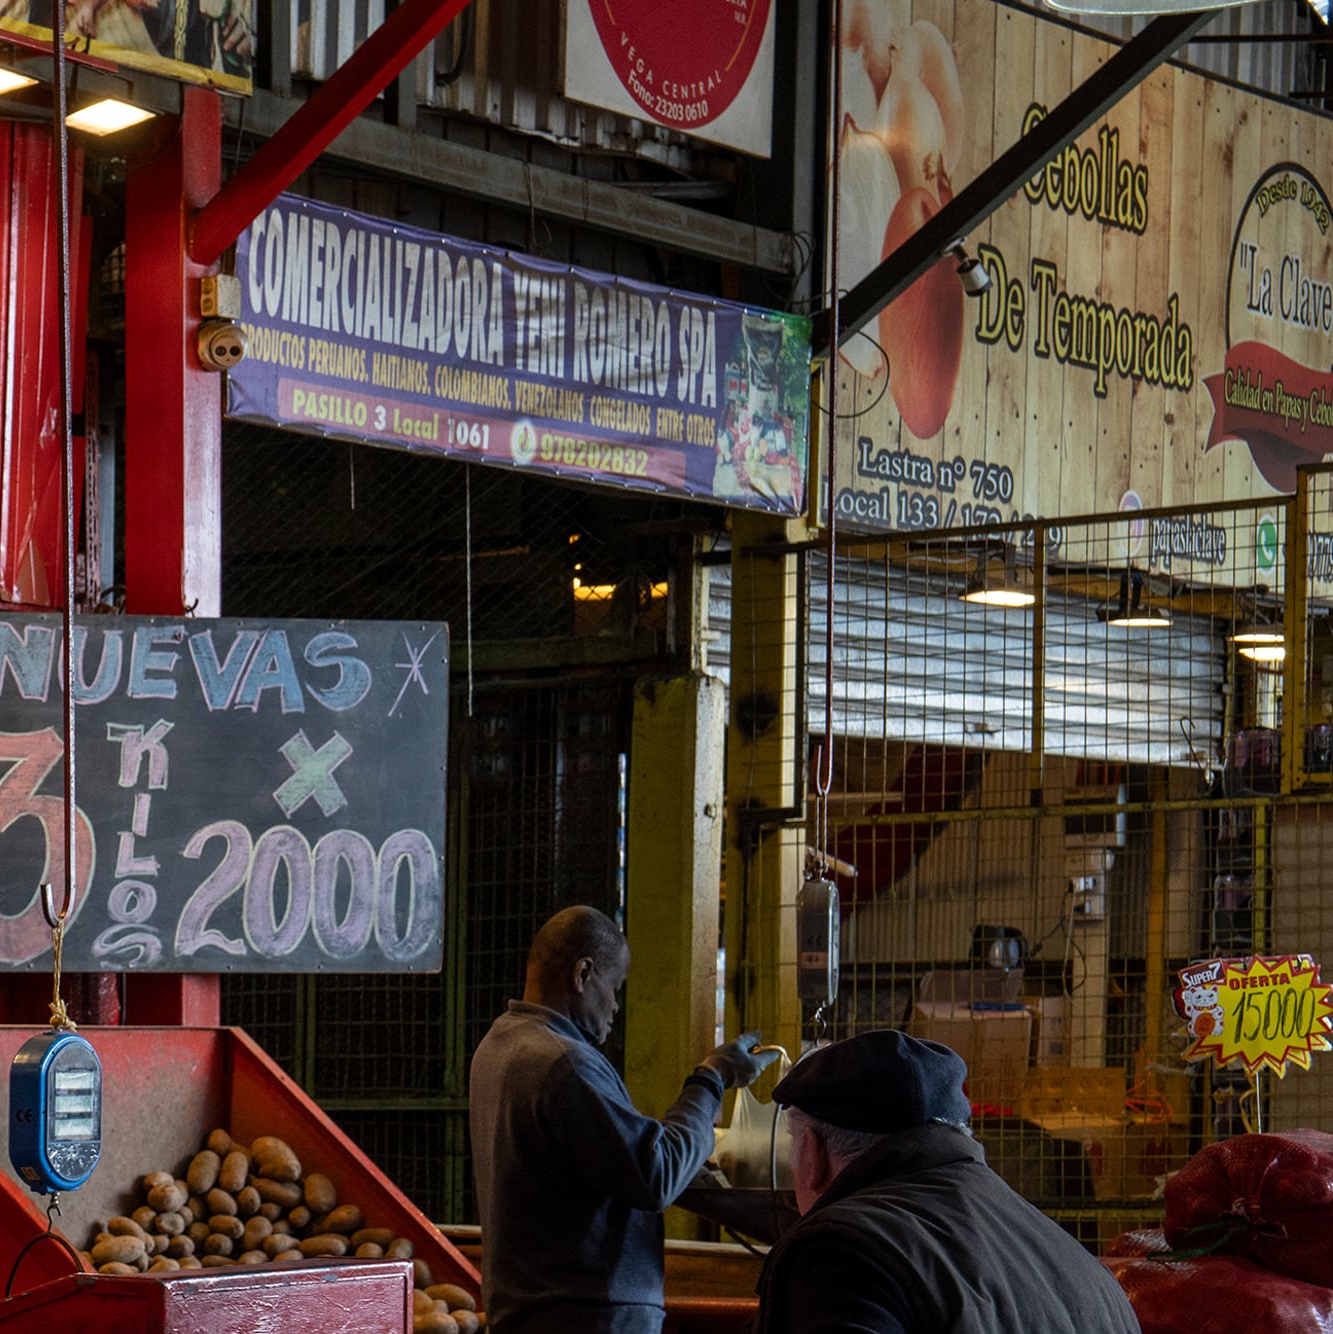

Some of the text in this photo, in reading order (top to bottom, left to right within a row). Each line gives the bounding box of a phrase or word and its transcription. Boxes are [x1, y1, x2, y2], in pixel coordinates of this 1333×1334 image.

[621, 32, 722, 99] VEGA CENTRAL
[628, 70, 655, 108] Fono:
[685, 99, 708, 121] 0610
[1256, 173, 1331, 235] Desde 1942
[248, 207, 504, 366] COMERCIALIZADORA
[573, 281, 671, 398] ROMERO
[678, 304, 717, 408] SPA
[977, 247, 1192, 398] De Temporada
[1279, 255, 1333, 332] Clave
[240, 323, 306, 376] PRODUCTOS
[515, 379, 584, 423] VENEZOLANOS
[590, 395, 651, 436] CONGELADOS
[656, 407, 683, 443] ENTRE
[687, 413, 716, 448] OTROS
[1224, 367, 1262, 411] Calidad
[1262, 384, 1275, 412] en
[1275, 379, 1302, 429] Papas
[1301, 399, 1310, 433] y
[292, 388, 649, 477] PASILLO 3 Local 1061 978202832
[859, 440, 934, 488] Lastra
[970, 462, 1014, 500] 750
[822, 480, 890, 521] Local
[898, 495, 939, 530] 133
[91, 718, 175, 968] KILOS
[173, 819, 439, 962] 2000
[1229, 972, 1291, 991] OFERTA
[1232, 987, 1316, 1044] 15000
